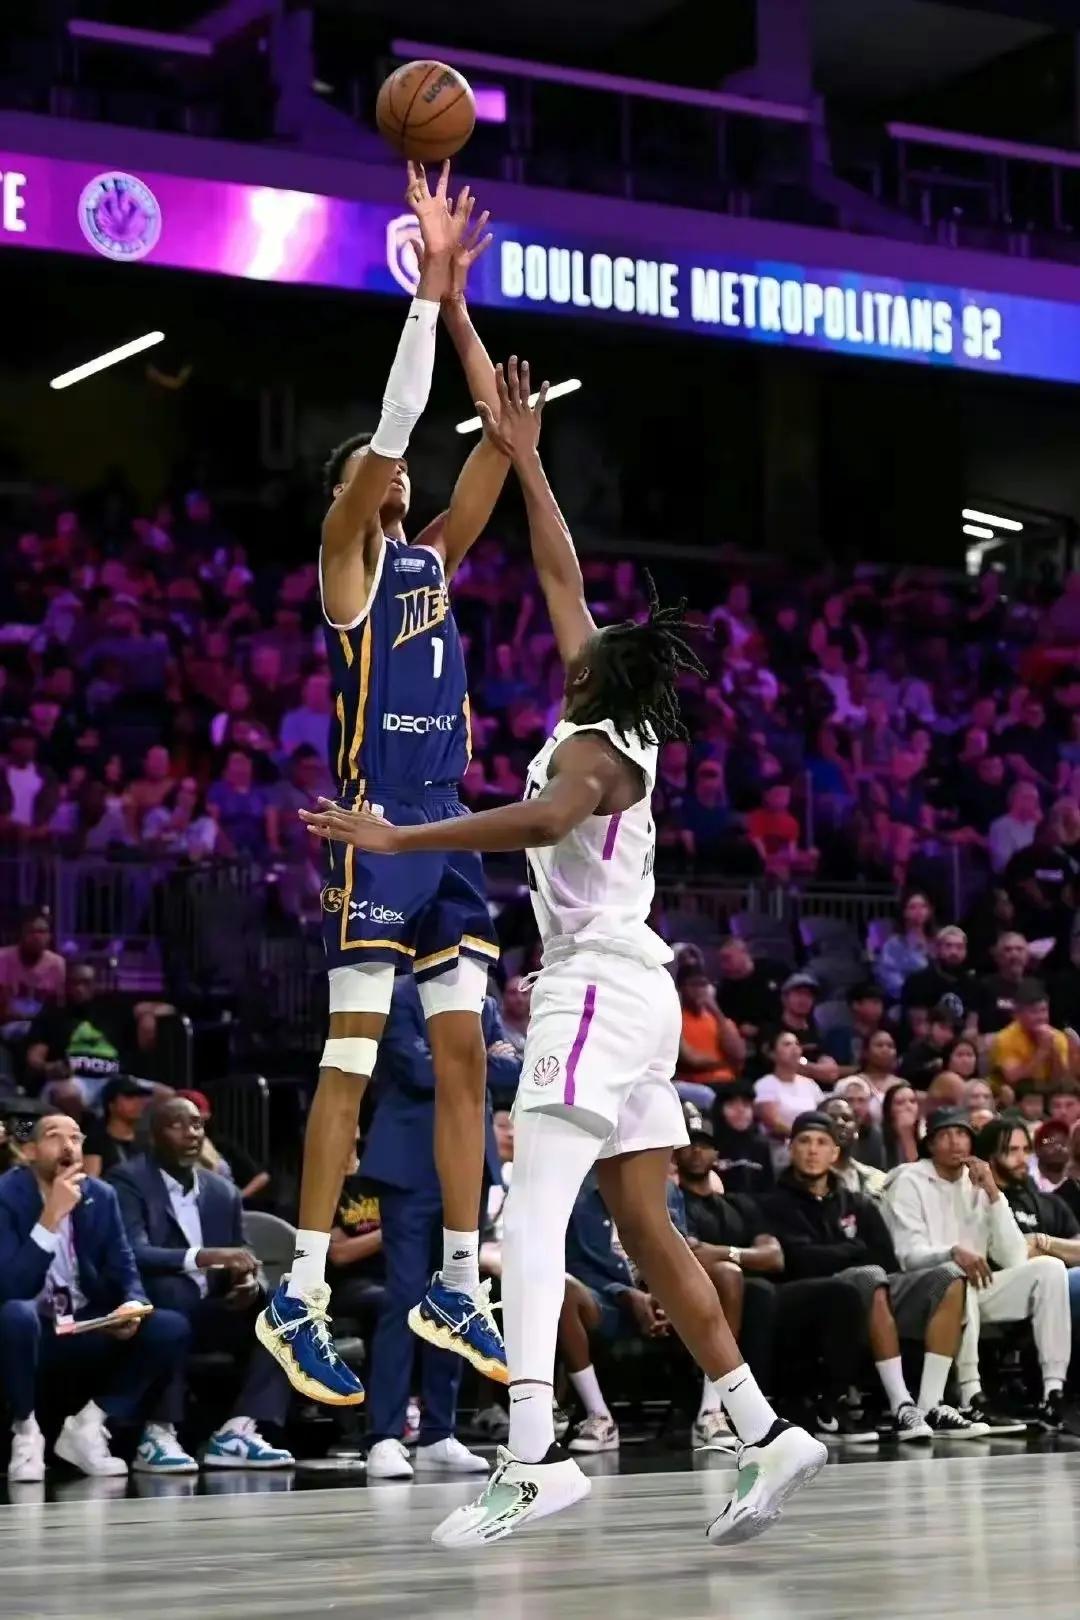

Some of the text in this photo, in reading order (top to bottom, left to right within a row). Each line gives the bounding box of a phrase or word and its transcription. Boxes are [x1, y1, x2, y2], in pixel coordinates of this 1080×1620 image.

[0, 171, 27, 232] E
[501, 240, 1002, 360] BOULOGNE METROPOLITANS 92
[431, 637, 444, 679] 1
[369, 902, 405, 922] idex
